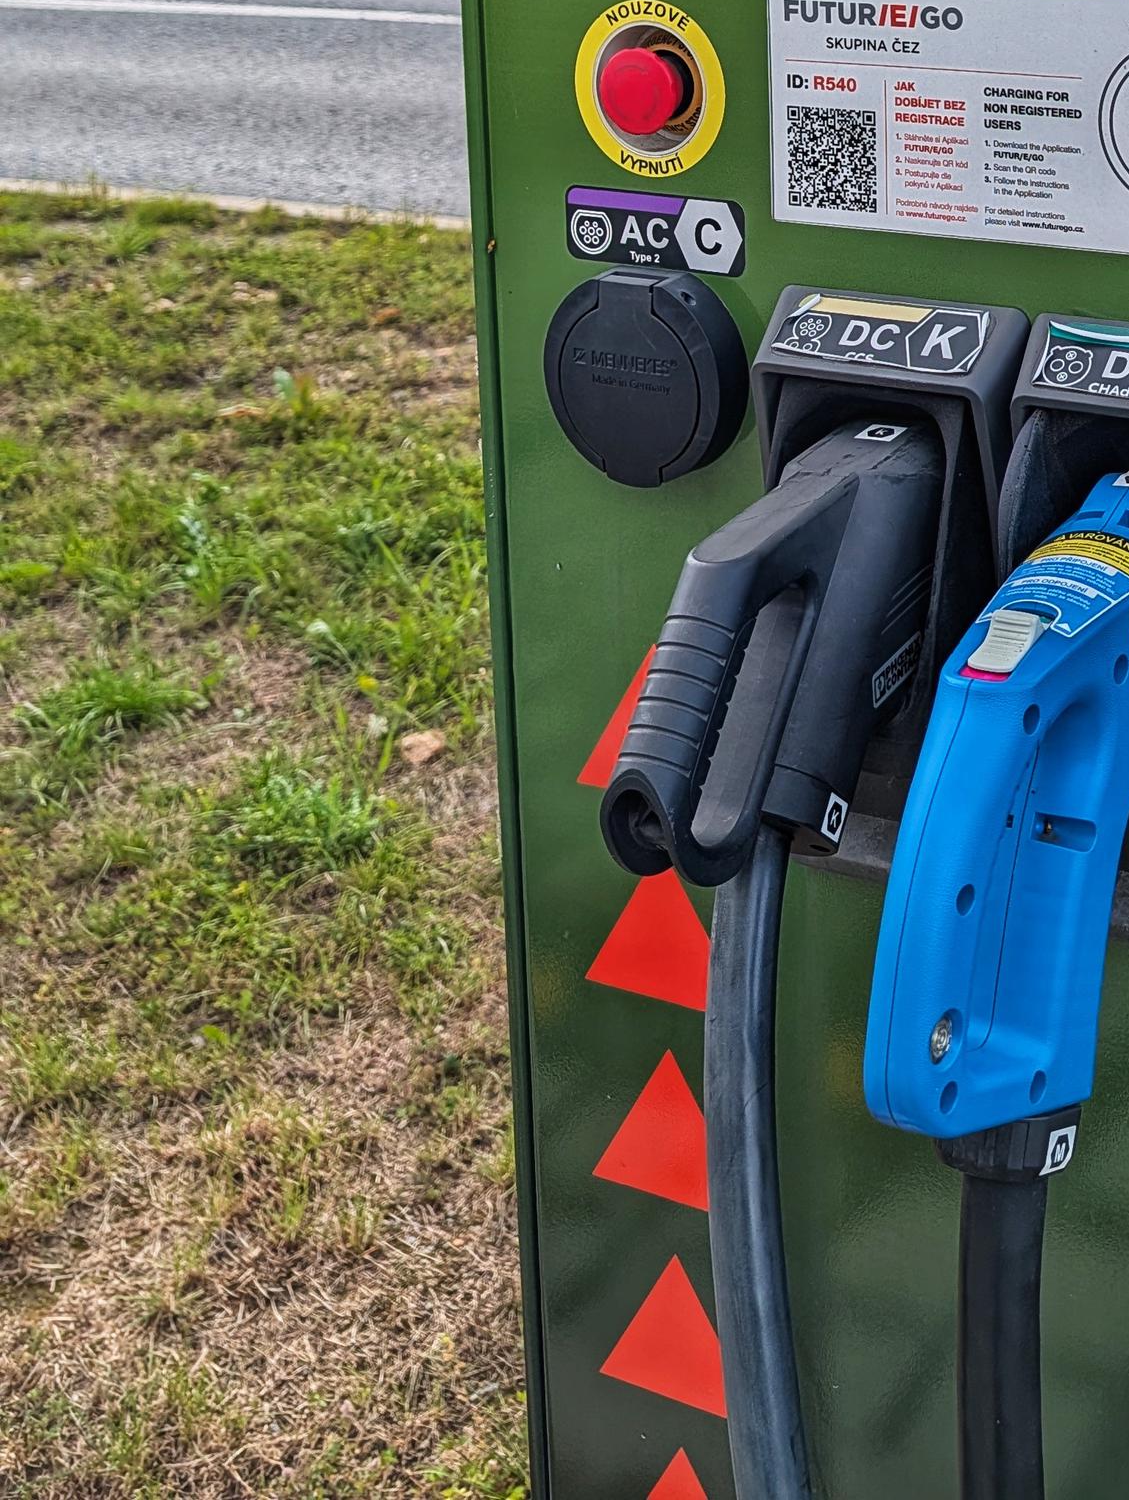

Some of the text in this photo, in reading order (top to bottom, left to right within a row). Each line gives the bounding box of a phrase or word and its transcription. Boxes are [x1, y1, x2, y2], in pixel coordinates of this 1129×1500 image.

[605, 1, 690, 32] NOUZOVÉ
[783, 0, 963, 31] FUTUR/E/GO
[826, 36, 920, 54] SKUPINA ČEZ
[787, 74, 857, 92] ID: R540
[894, 81, 915, 92] JAK
[983, 87, 1069, 102] CHARGING FOR
[895, 96, 966, 111] DOBÍJET BEZ
[984, 103, 1082, 119] NON REGISTERED
[895, 113, 965, 127] REGISTRACE
[984, 119, 1021, 131] USERS
[942, 136, 969, 145] Aplikaci
[993, 140, 1028, 150] Download
[1029, 143, 1040, 151] the
[619, 150, 684, 175] VYPNUTÍ
[942, 159, 954, 167] QR
[955, 160, 968, 169] kód
[993, 164, 1011, 173] Scan
[1012, 165, 1024, 173] the
[1025, 167, 1036, 175] QR
[1038, 168, 1056, 176] code
[993, 176, 1016, 186] Follow
[1017, 178, 1028, 187] the
[1014, 189, 1053, 199] Application
[985, 206, 996, 214] For
[997, 207, 1024, 217] detailed
[985, 217, 1006, 227] please
[1008, 219, 1021, 227] visit
[620, 215, 669, 250] AC
[694, 218, 722, 255] C
[629, 251, 660, 264] Type 2
[838, 320, 900, 350] DC
[920, 324, 967, 360] K
[592, 374, 671, 395] Made in Germany
[830, 809, 841, 828] K
[1053, 1142, 1067, 1165] M
